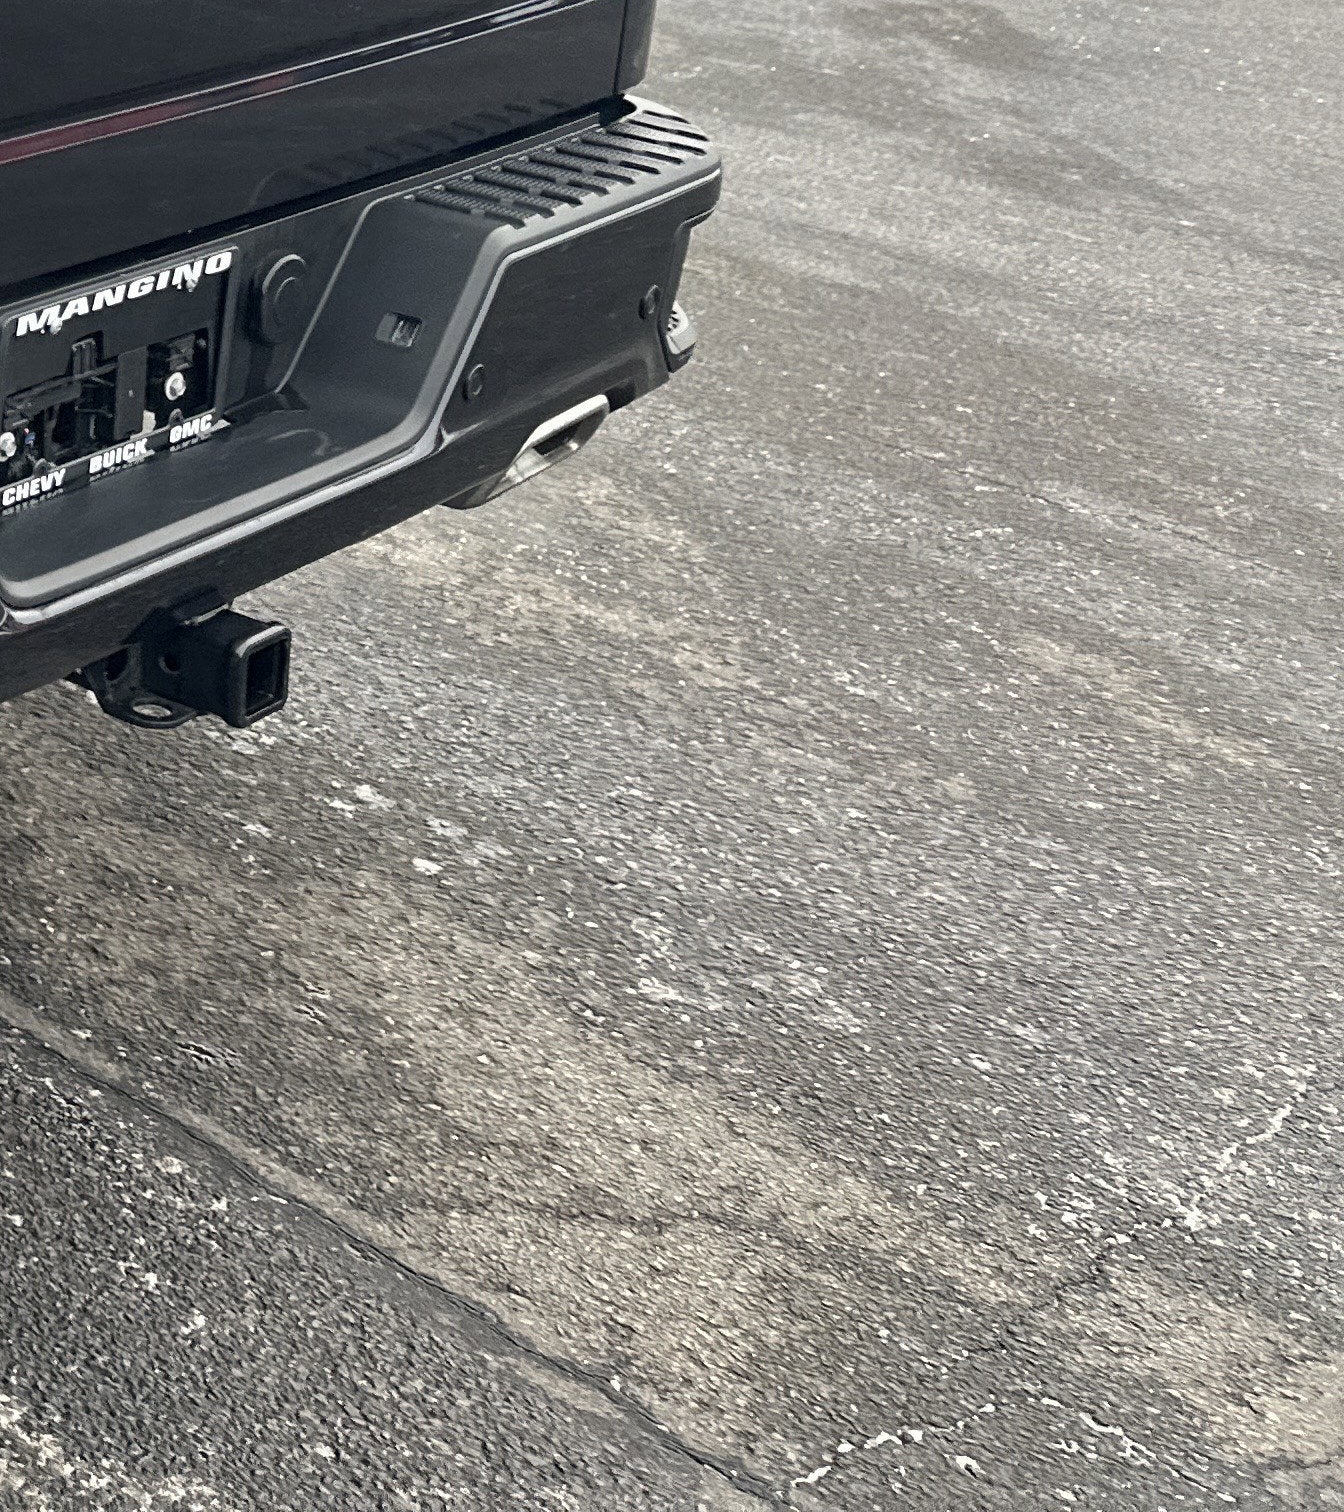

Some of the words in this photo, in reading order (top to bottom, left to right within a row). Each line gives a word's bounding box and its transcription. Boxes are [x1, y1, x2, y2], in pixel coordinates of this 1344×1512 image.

[16, 251, 232, 336] MANGINO
[2, 468, 66, 506] CHEVY
[89, 438, 148, 474] BUICK
[169, 414, 212, 444] GMC
